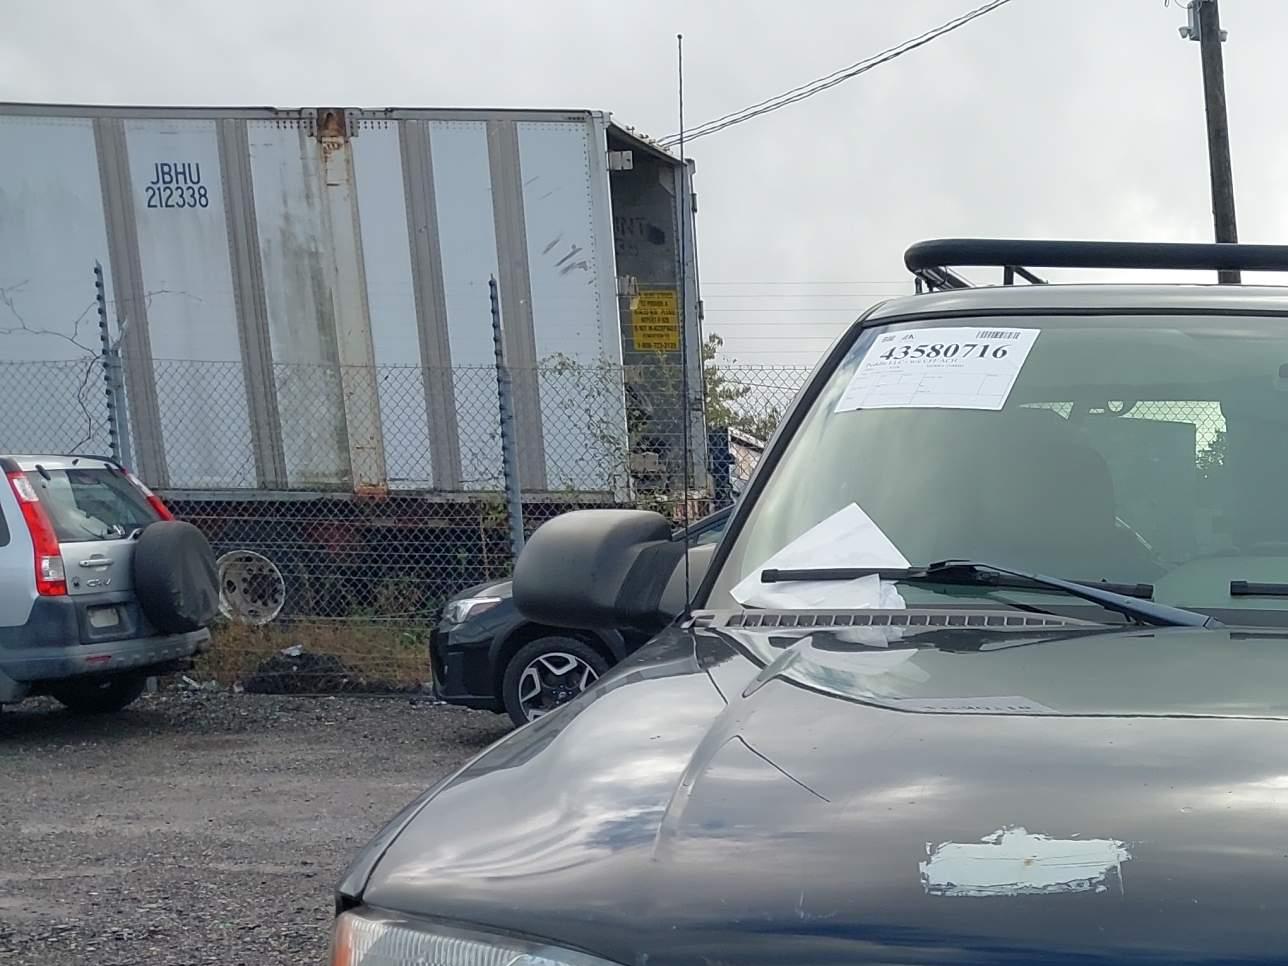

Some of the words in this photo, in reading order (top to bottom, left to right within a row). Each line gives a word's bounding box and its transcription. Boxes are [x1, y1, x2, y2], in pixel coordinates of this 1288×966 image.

[150, 162, 200, 185] JBHU
[145, 186, 209, 208] 212338
[880, 343, 1012, 361] 43580716
